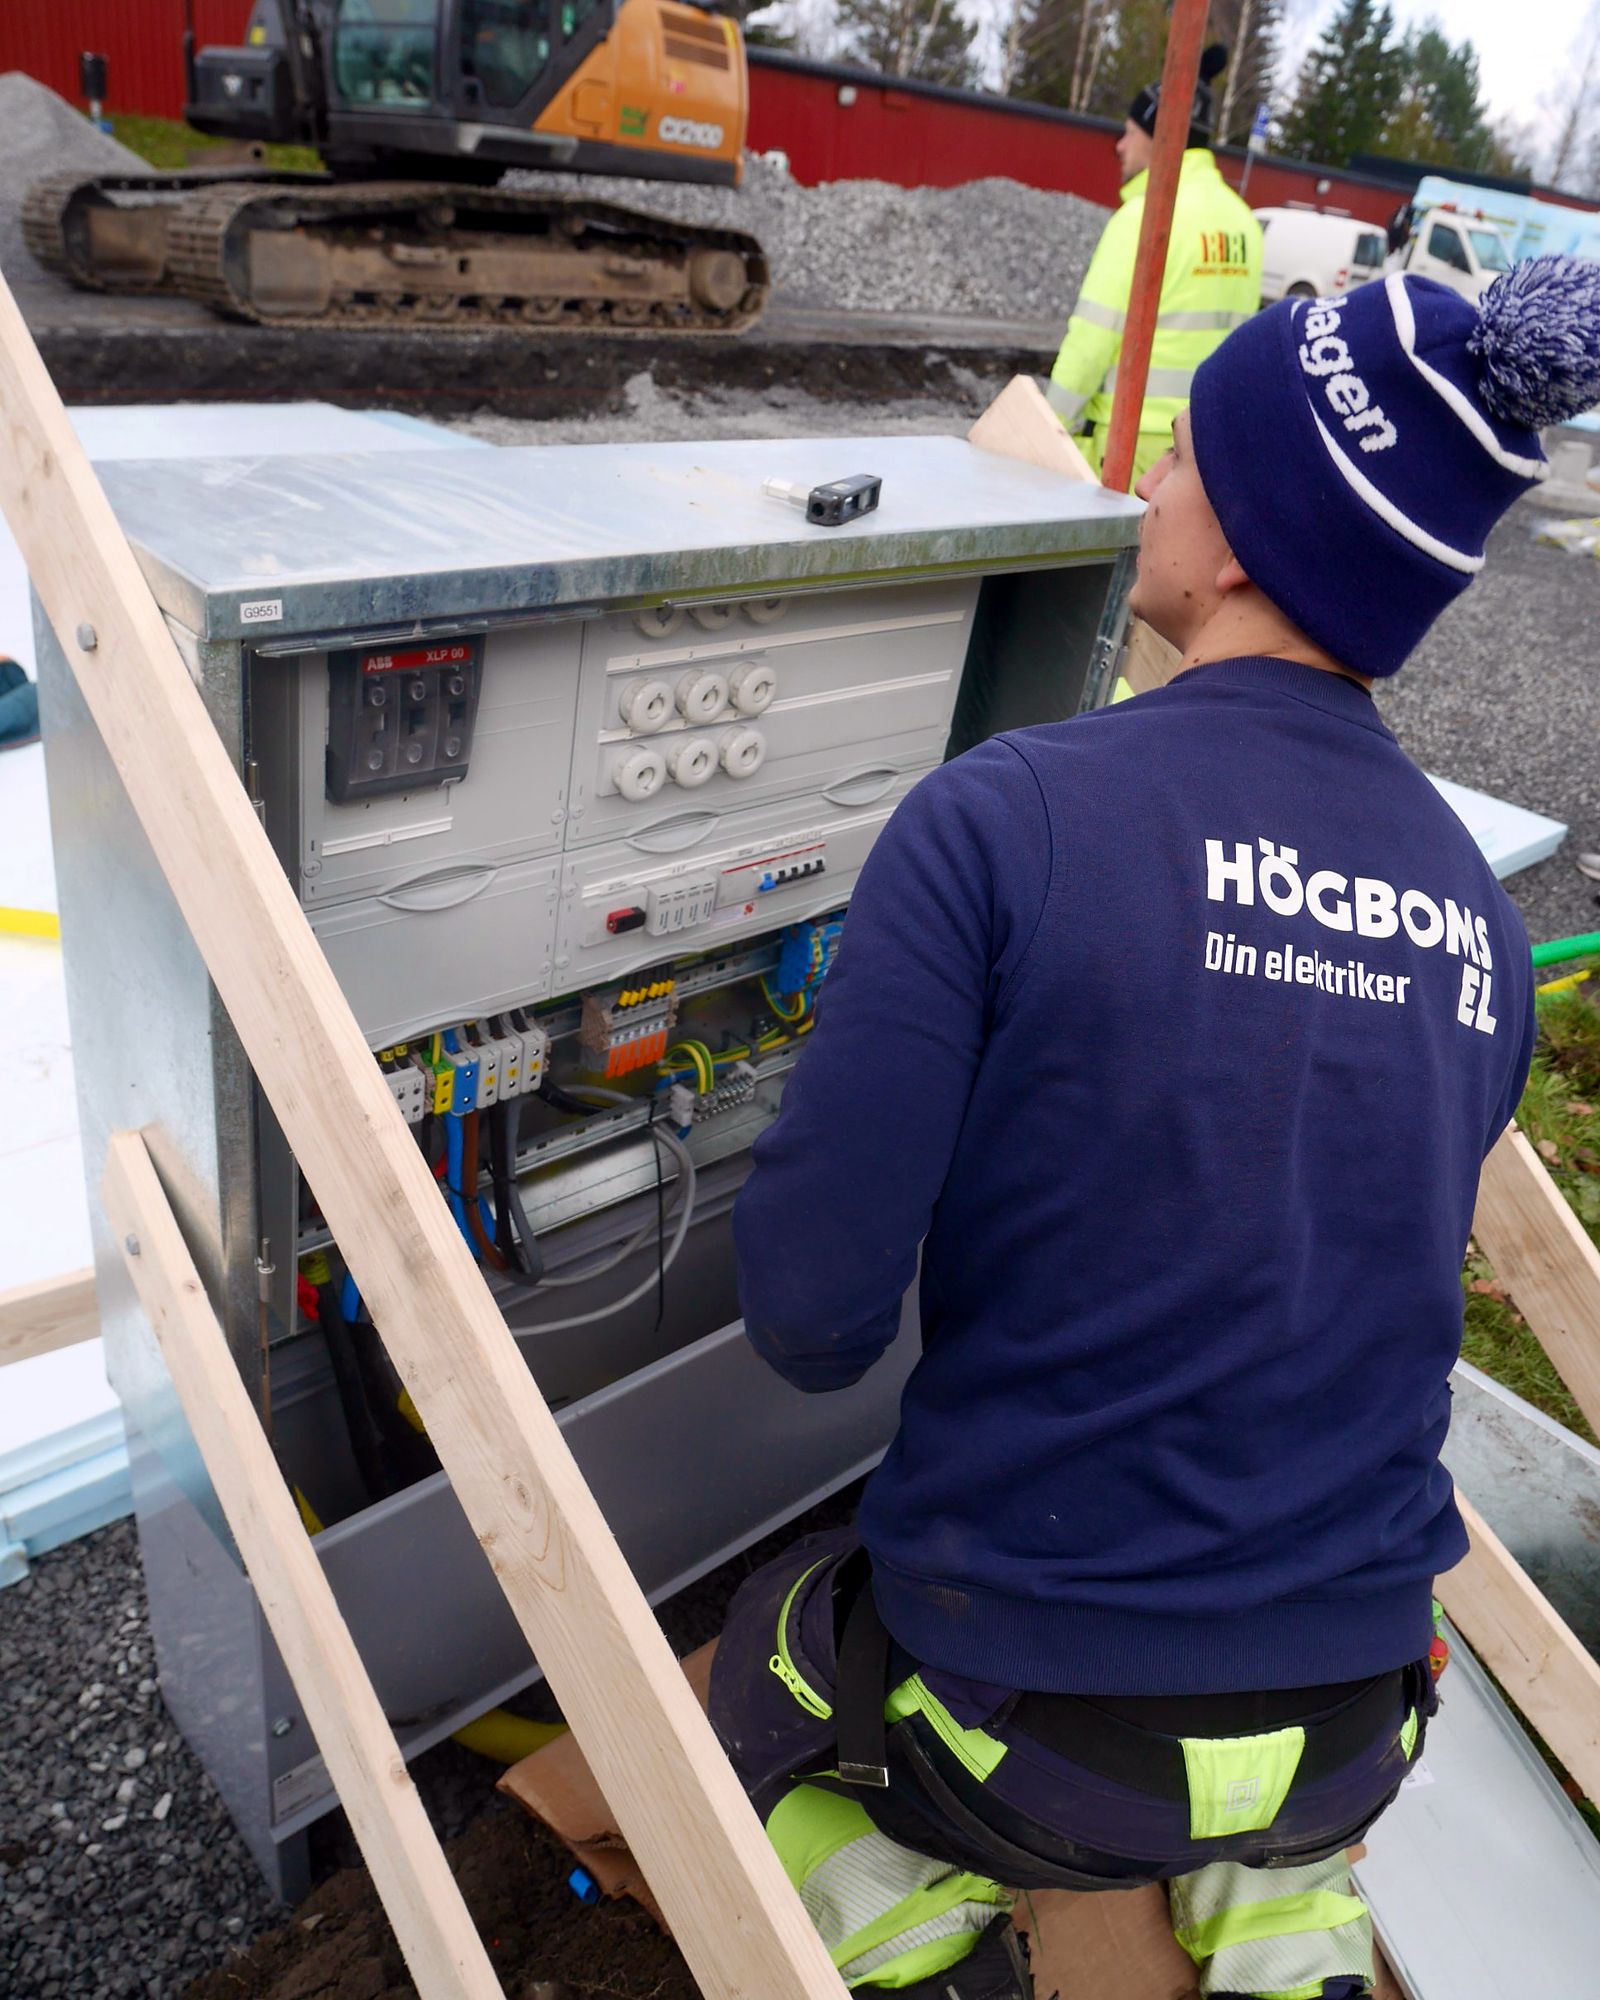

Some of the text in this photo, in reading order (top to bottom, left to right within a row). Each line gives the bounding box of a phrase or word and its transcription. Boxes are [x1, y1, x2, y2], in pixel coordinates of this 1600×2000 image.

[243, 604, 278, 619] G9551
[366, 656, 393, 671] ABB
[426, 647, 465, 663] XLP 00
[1205, 837, 1493, 970] HÖGBOMS
[1204, 931, 1411, 1004] Din elektriker
[1457, 963, 1497, 1035] EL
